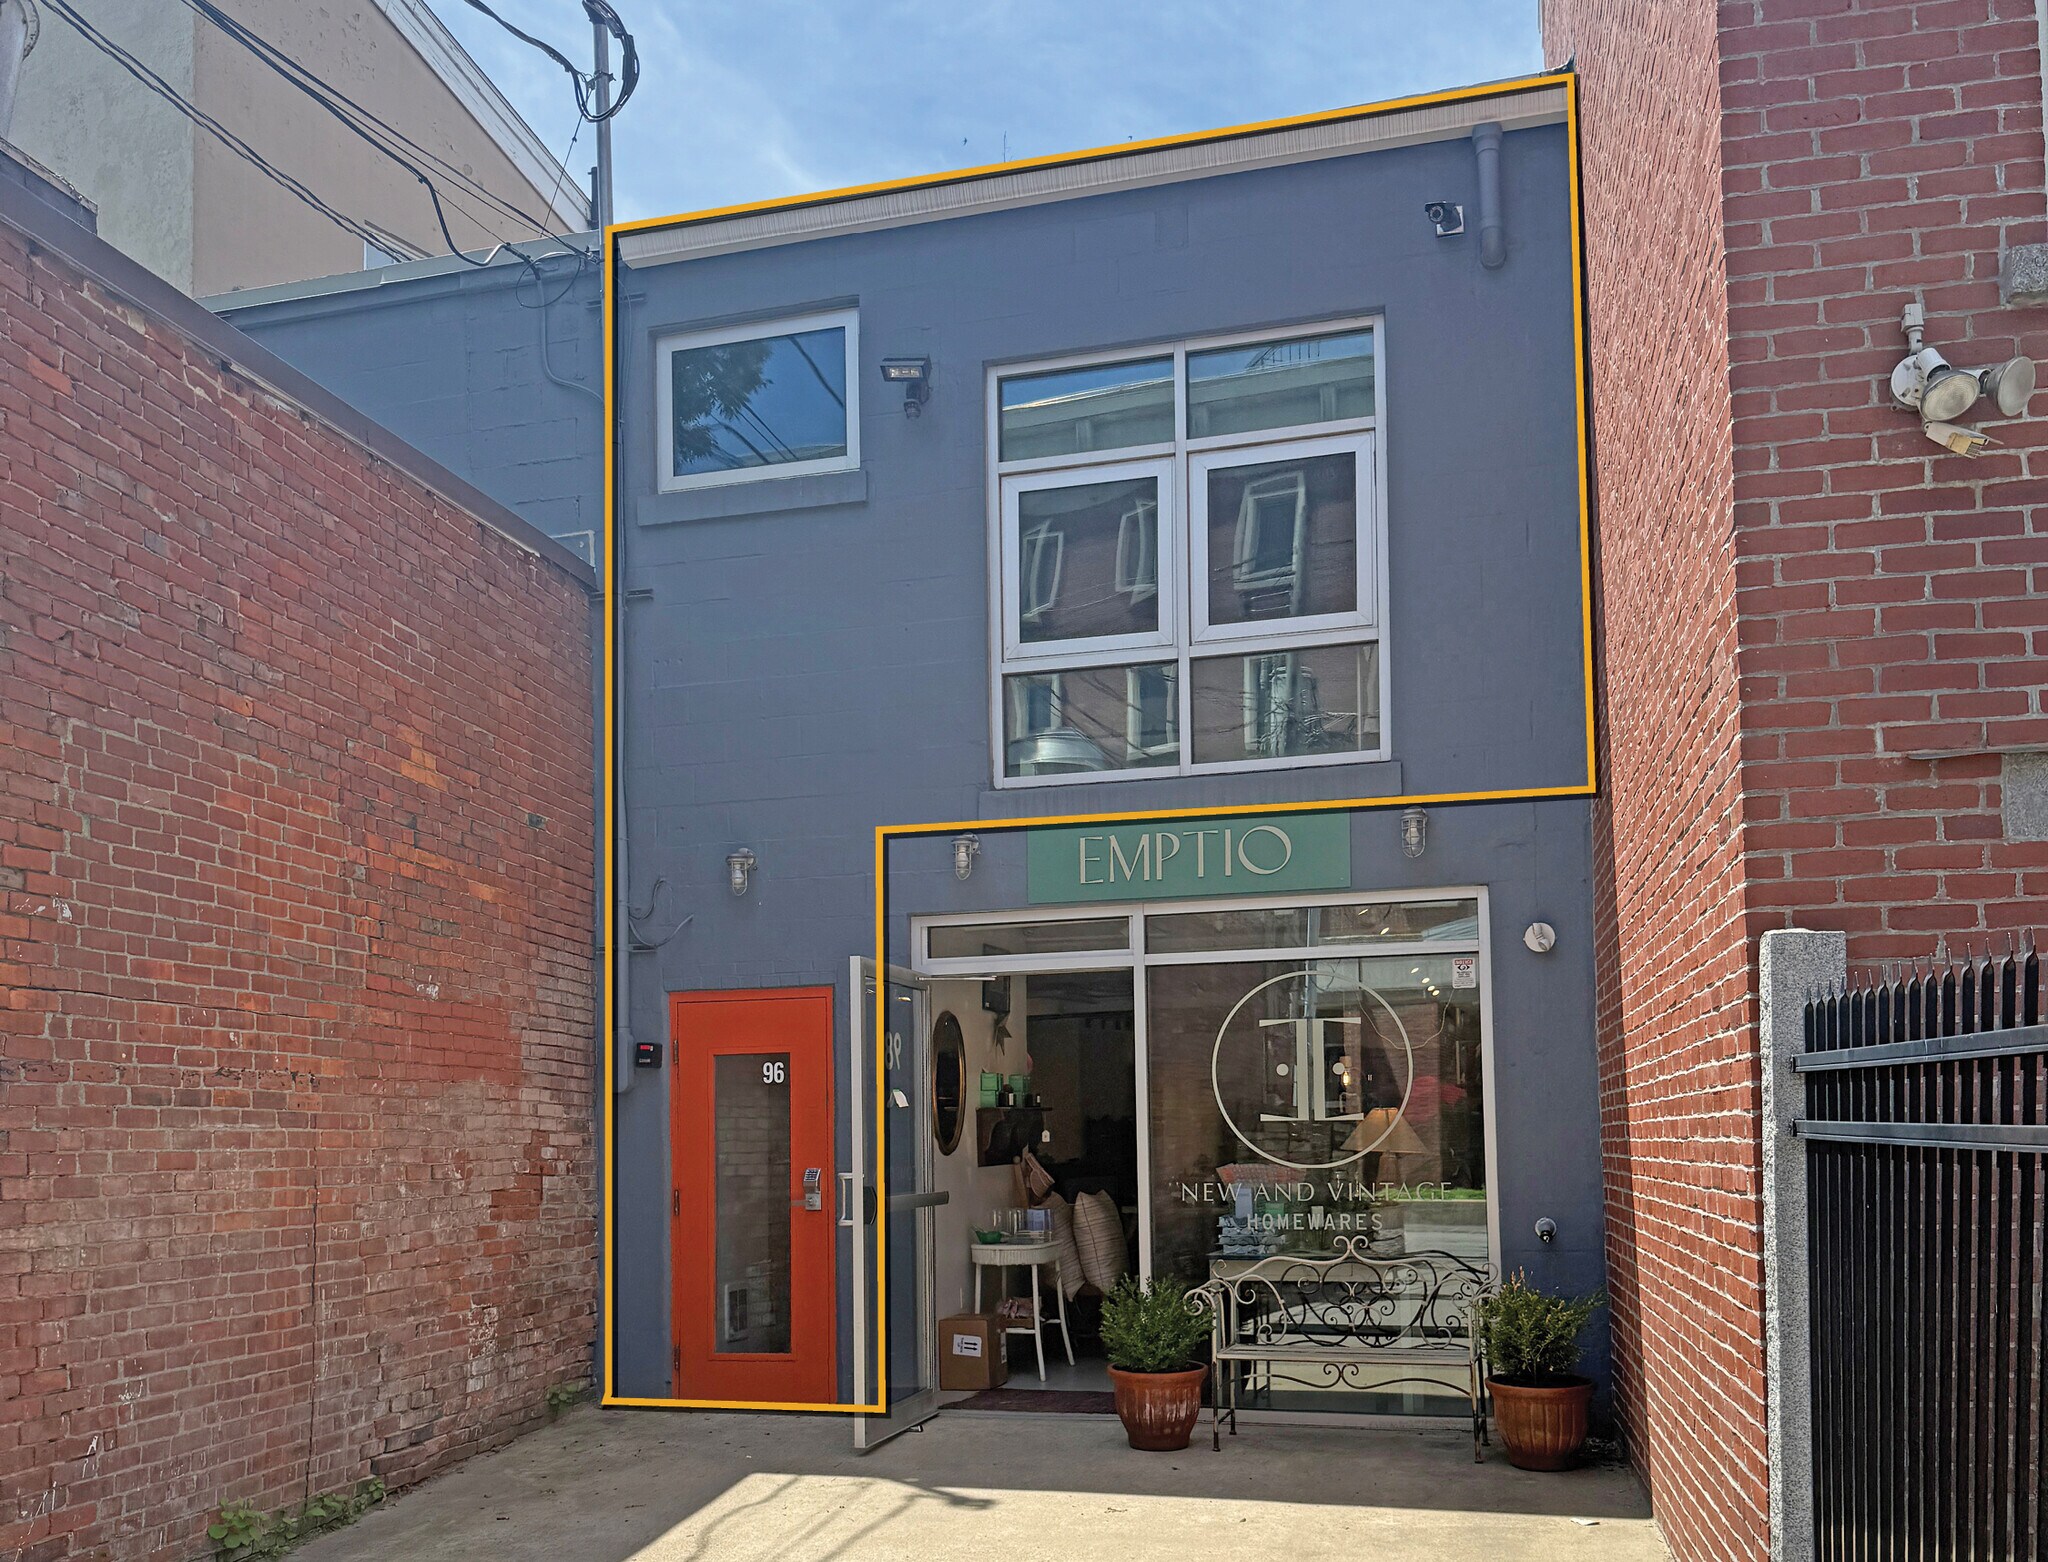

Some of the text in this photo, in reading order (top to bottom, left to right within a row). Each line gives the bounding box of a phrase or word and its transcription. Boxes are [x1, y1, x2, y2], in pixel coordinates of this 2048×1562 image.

[1080, 825, 1293, 885] EMPTIO
[763, 1061, 785, 1084] 96
[1181, 1181, 1452, 1202] NEW AND VINTAGE
[1247, 1213, 1383, 1231] HOMEWARES
